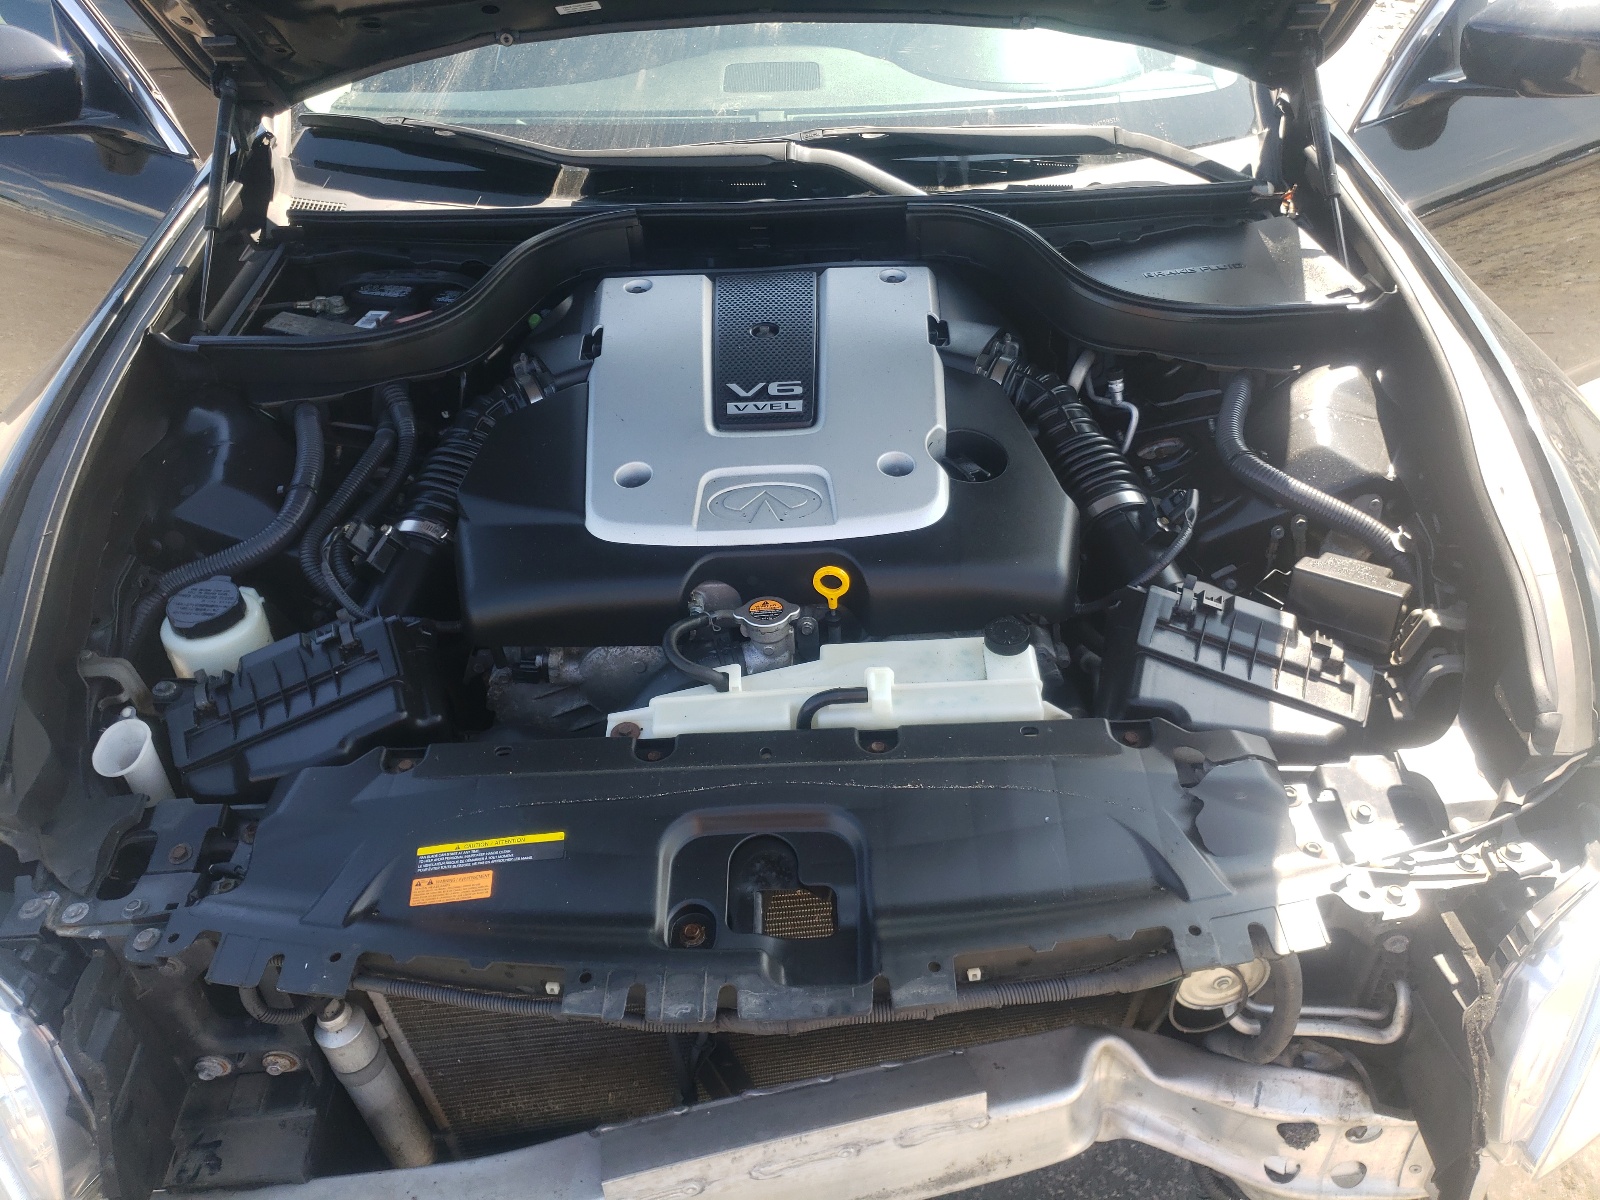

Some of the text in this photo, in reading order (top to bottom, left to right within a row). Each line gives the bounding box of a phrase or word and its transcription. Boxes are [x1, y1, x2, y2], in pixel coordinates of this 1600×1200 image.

[1143, 262, 1244, 278] BRAKE FLUID
[726, 381, 803, 397] V6
[733, 402, 797, 411] VVEL
